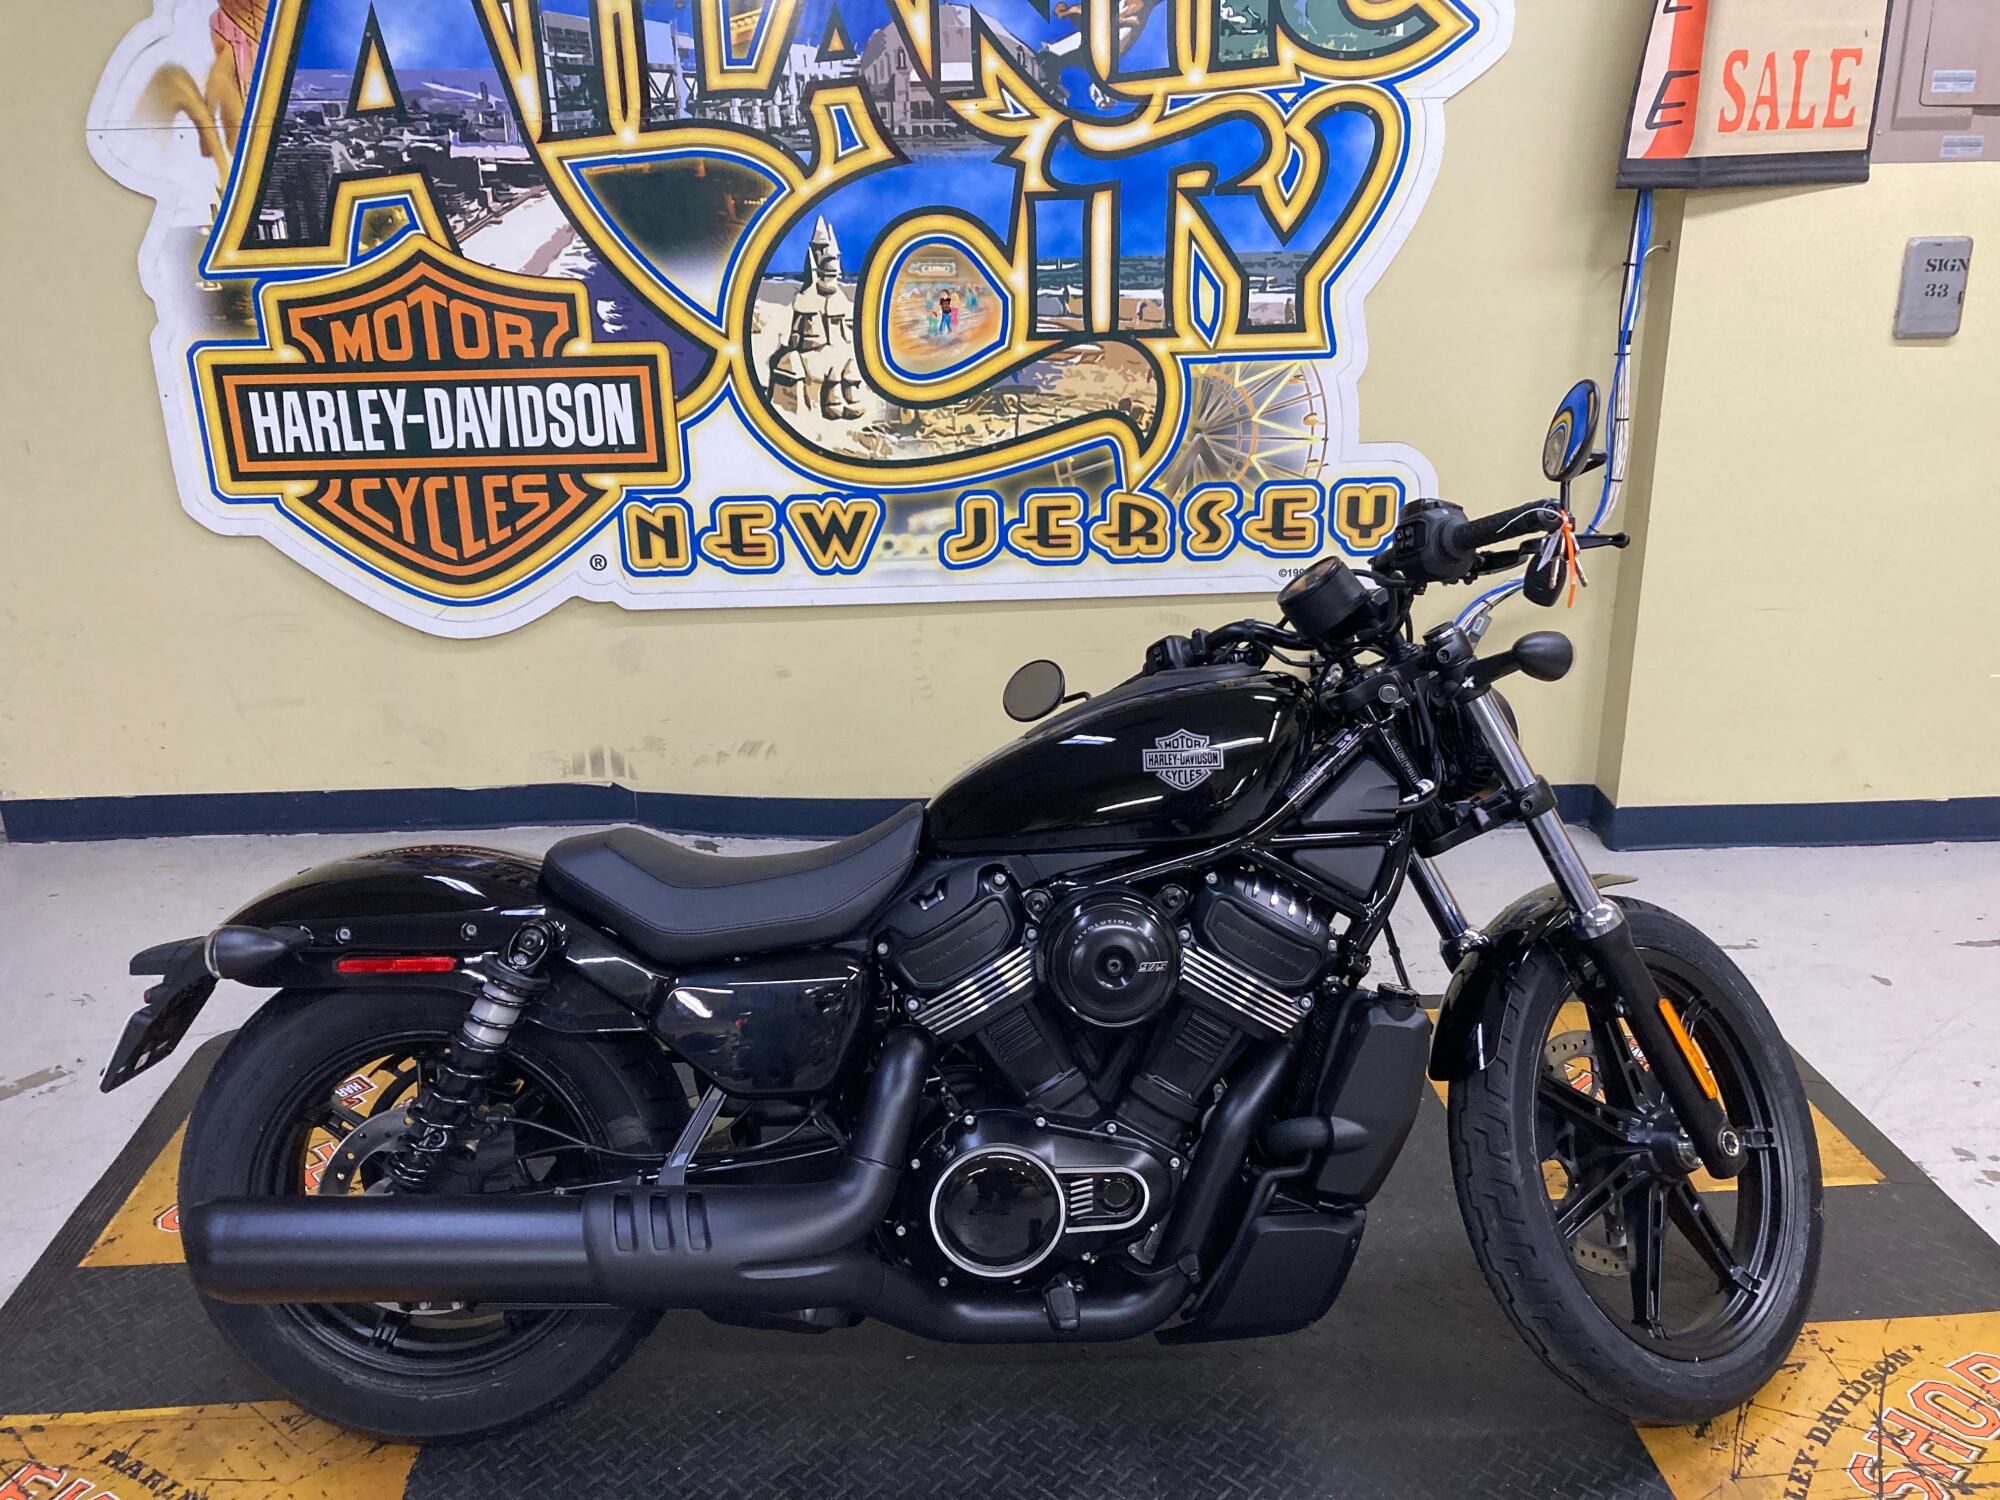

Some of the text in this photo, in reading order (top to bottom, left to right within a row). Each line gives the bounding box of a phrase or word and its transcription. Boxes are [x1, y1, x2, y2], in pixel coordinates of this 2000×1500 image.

[1717, 48, 1863, 133] SALE
[738, 85, 1408, 490] CITY
[1925, 258, 1969, 272] SIGN
[329, 284, 534, 361] MOTOR
[248, 384, 636, 453] HARLEY-DAVIDSON
[353, 474, 550, 558] CYCLES
[624, 482, 1400, 570] NEW JERSEY
[1148, 752, 1218, 766] HARLEY-DAVIDSON
[1165, 736, 1200, 748] MOTOR
[1166, 769, 1202, 785] CYCLES
[1138, 960, 1169, 973] 975
